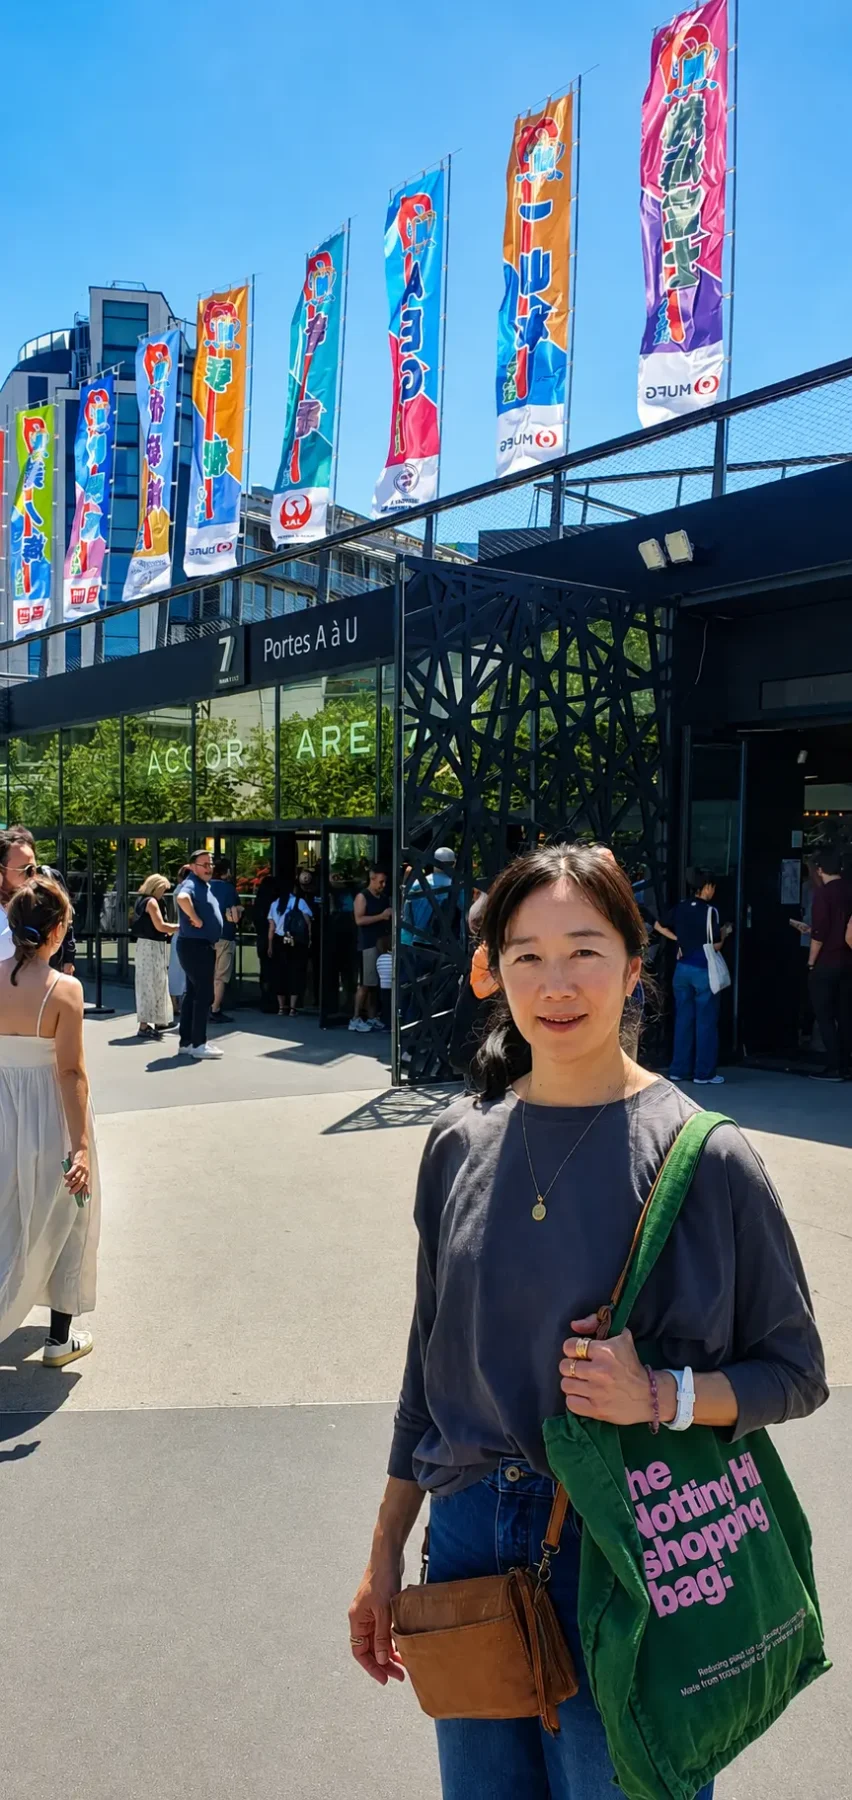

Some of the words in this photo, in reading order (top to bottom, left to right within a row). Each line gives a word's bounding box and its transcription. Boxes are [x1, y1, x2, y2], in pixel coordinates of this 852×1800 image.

[218, 636, 235, 672] 7
[264, 634, 310, 662] Portes
[315, 625, 327, 650] A
[331, 620, 340, 647] à
[345, 616, 358, 643] U
[625, 1461, 672, 1501] he
